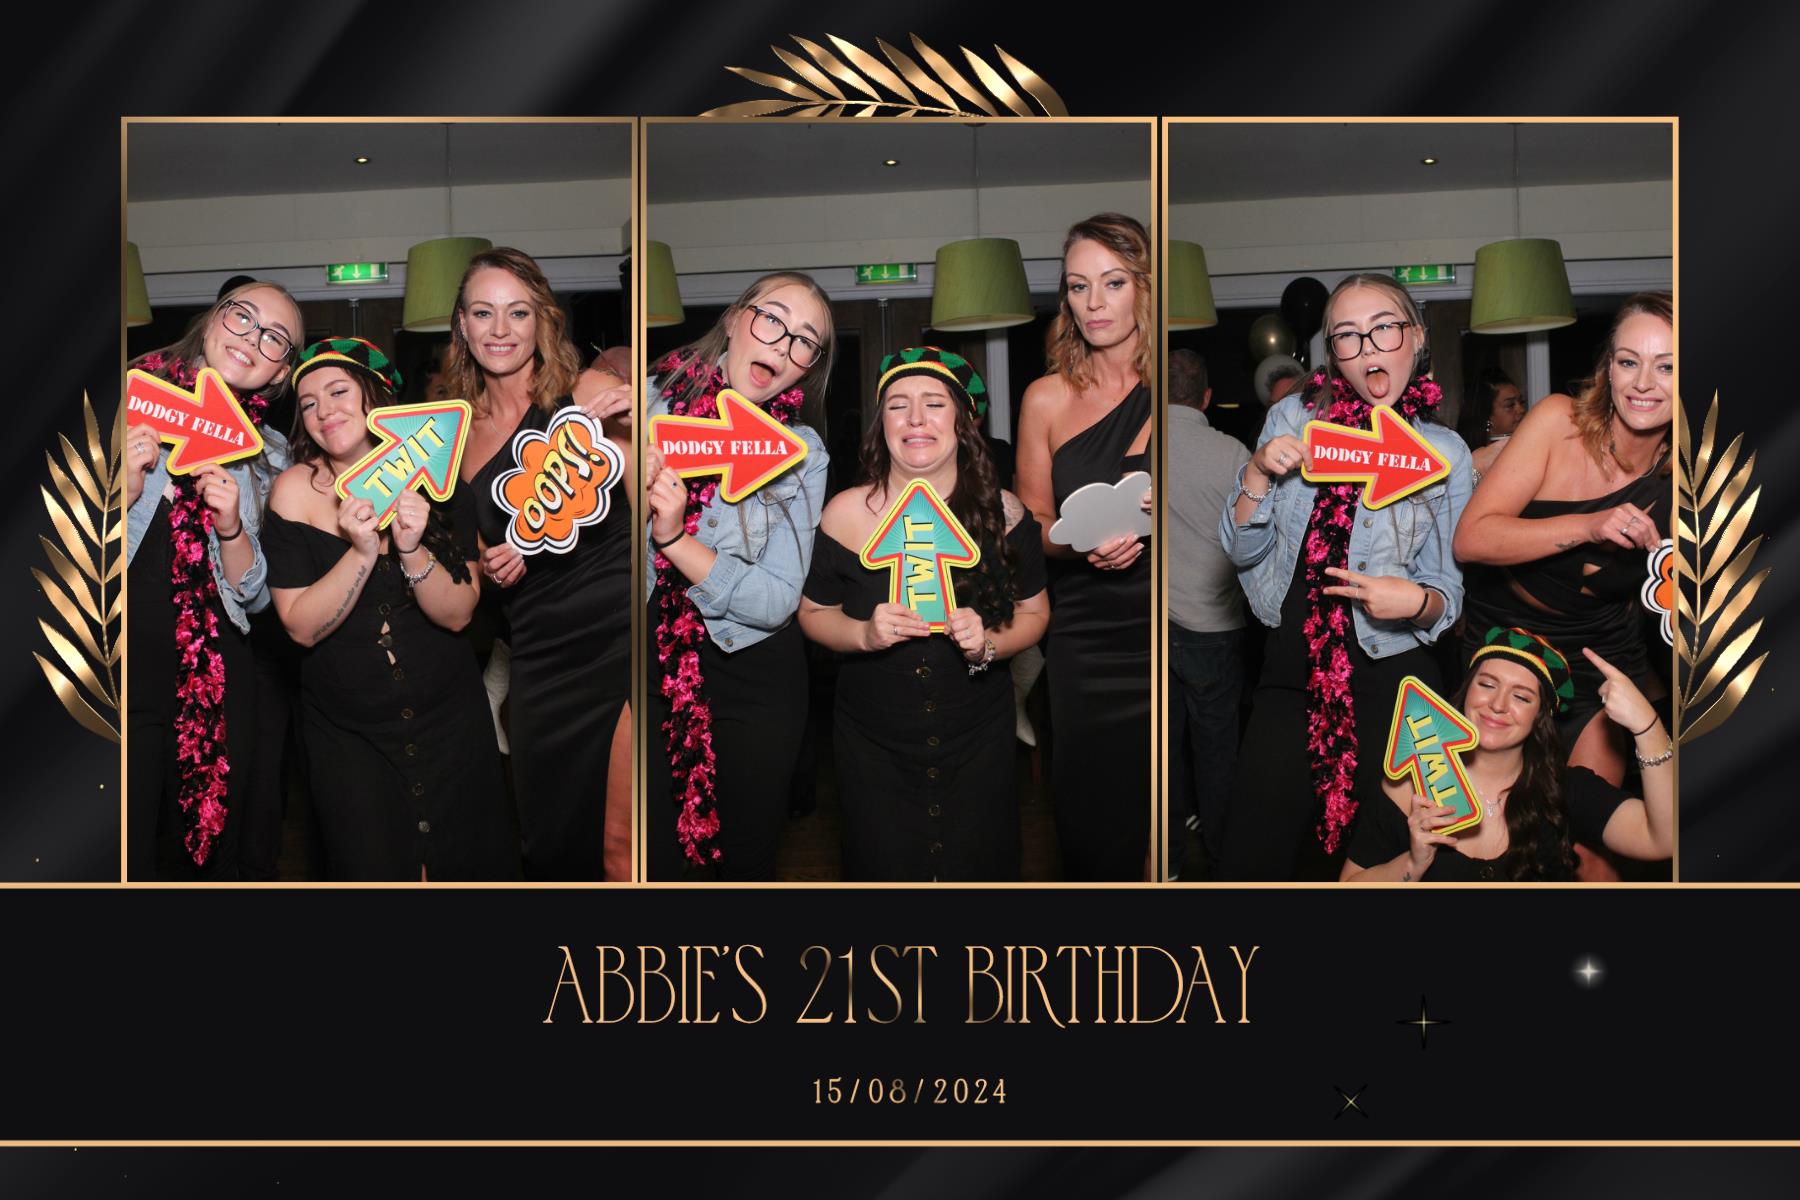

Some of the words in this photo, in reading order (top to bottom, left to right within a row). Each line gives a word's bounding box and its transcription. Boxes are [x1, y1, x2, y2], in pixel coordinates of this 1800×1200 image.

[128, 395, 188, 426] DODGY
[191, 416, 245, 447] FELLA
[363, 416, 444, 497] TWIT
[662, 440, 725, 455] DODGY
[730, 440, 788, 455] FELLA
[1313, 445, 1373, 465] DODGY
[1377, 452, 1432, 472] FELLA
[522, 418, 604, 532] OOPS!
[902, 515, 937, 611] TWIT
[1405, 714, 1457, 808] TWIT
